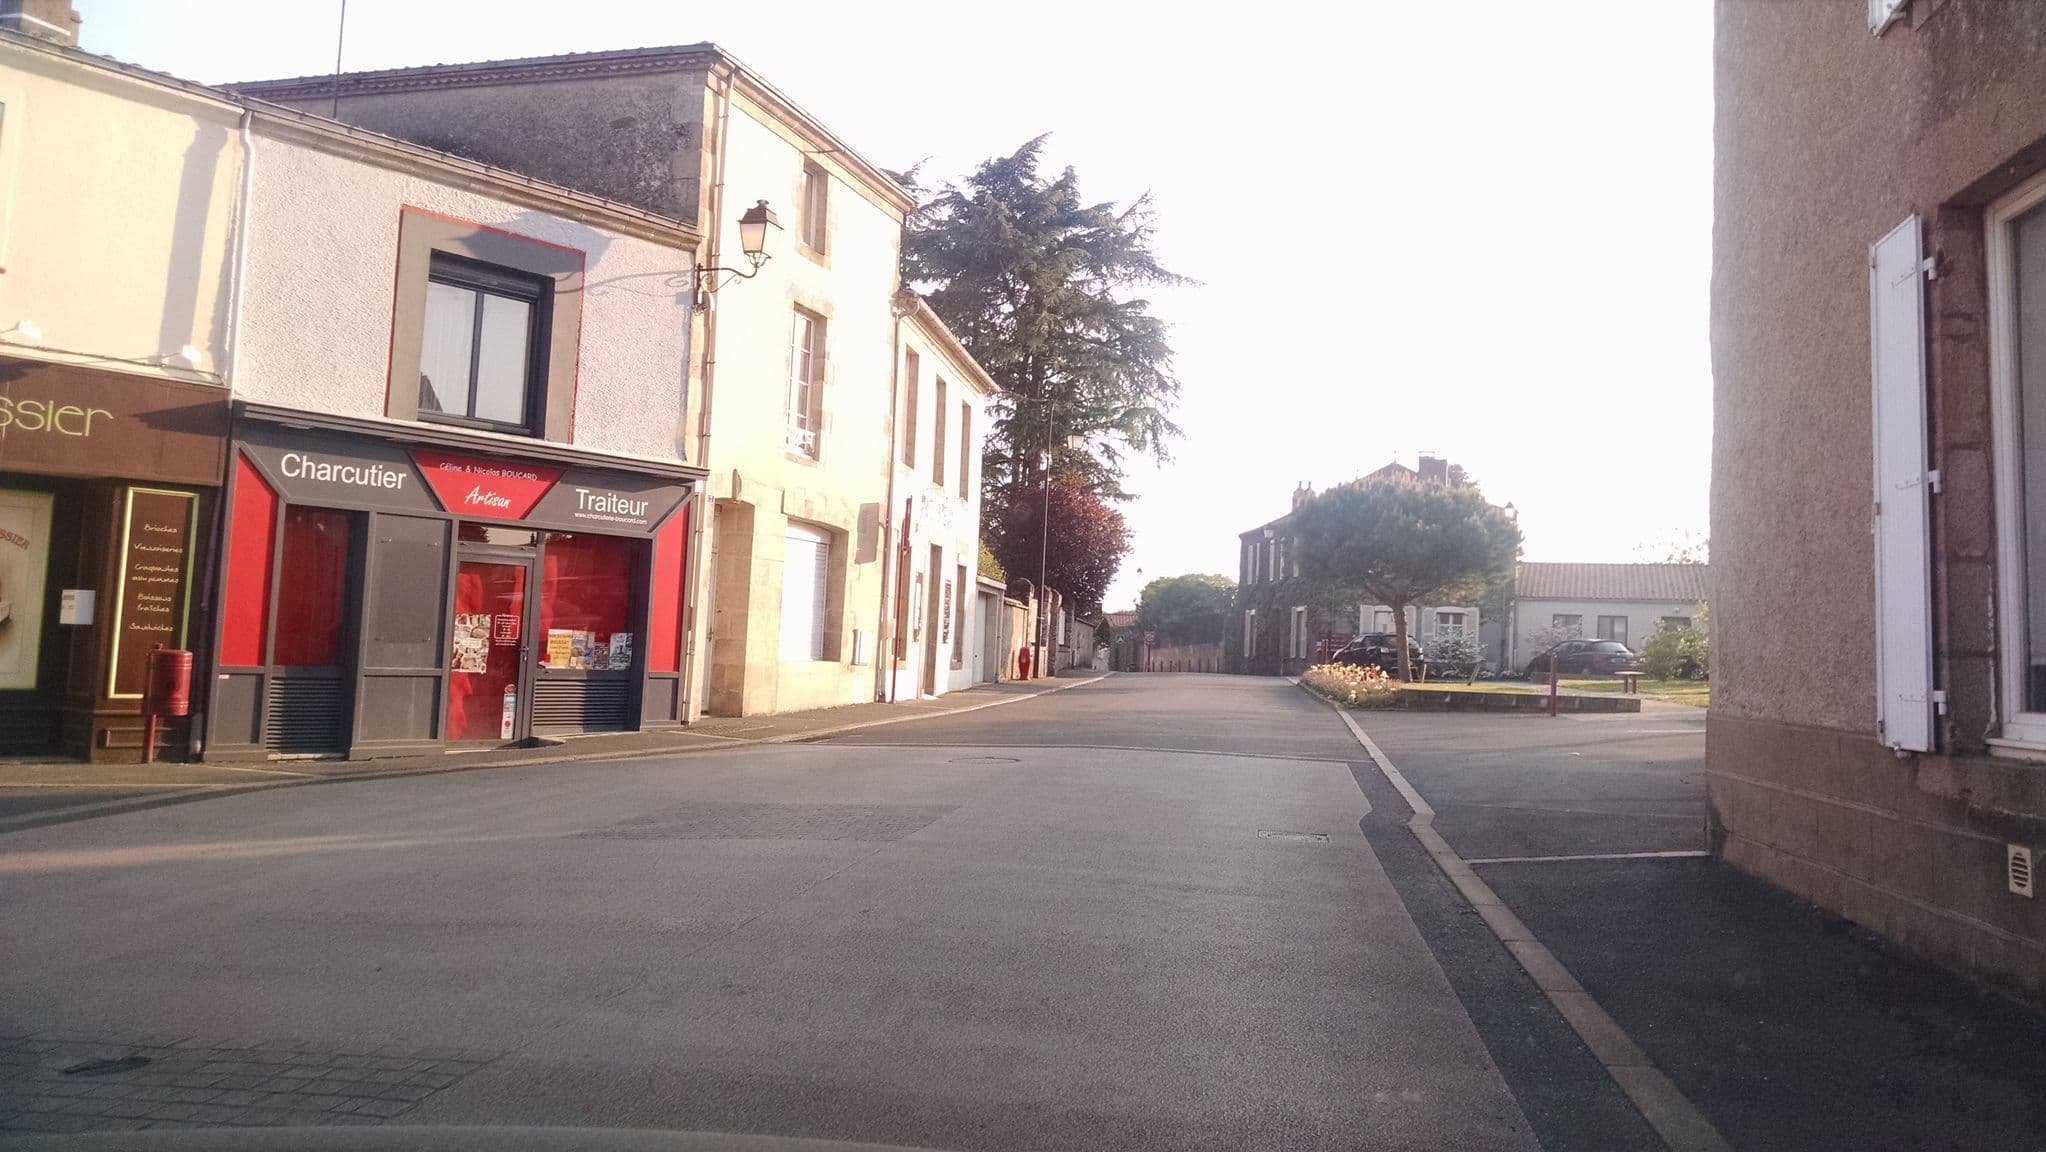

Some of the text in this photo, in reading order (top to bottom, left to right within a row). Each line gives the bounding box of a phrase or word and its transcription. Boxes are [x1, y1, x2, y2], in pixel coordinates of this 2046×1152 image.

[281, 453, 407, 489] Charcutier
[440, 462, 537, 481] Céline & Nicolas BOUCARD
[464, 485, 511, 508] Artisan
[575, 488, 648, 516] Traiteur
[144, 524, 177, 533] Brioches
[574, 513, 648, 525] www.charcuterie-boucard.com
